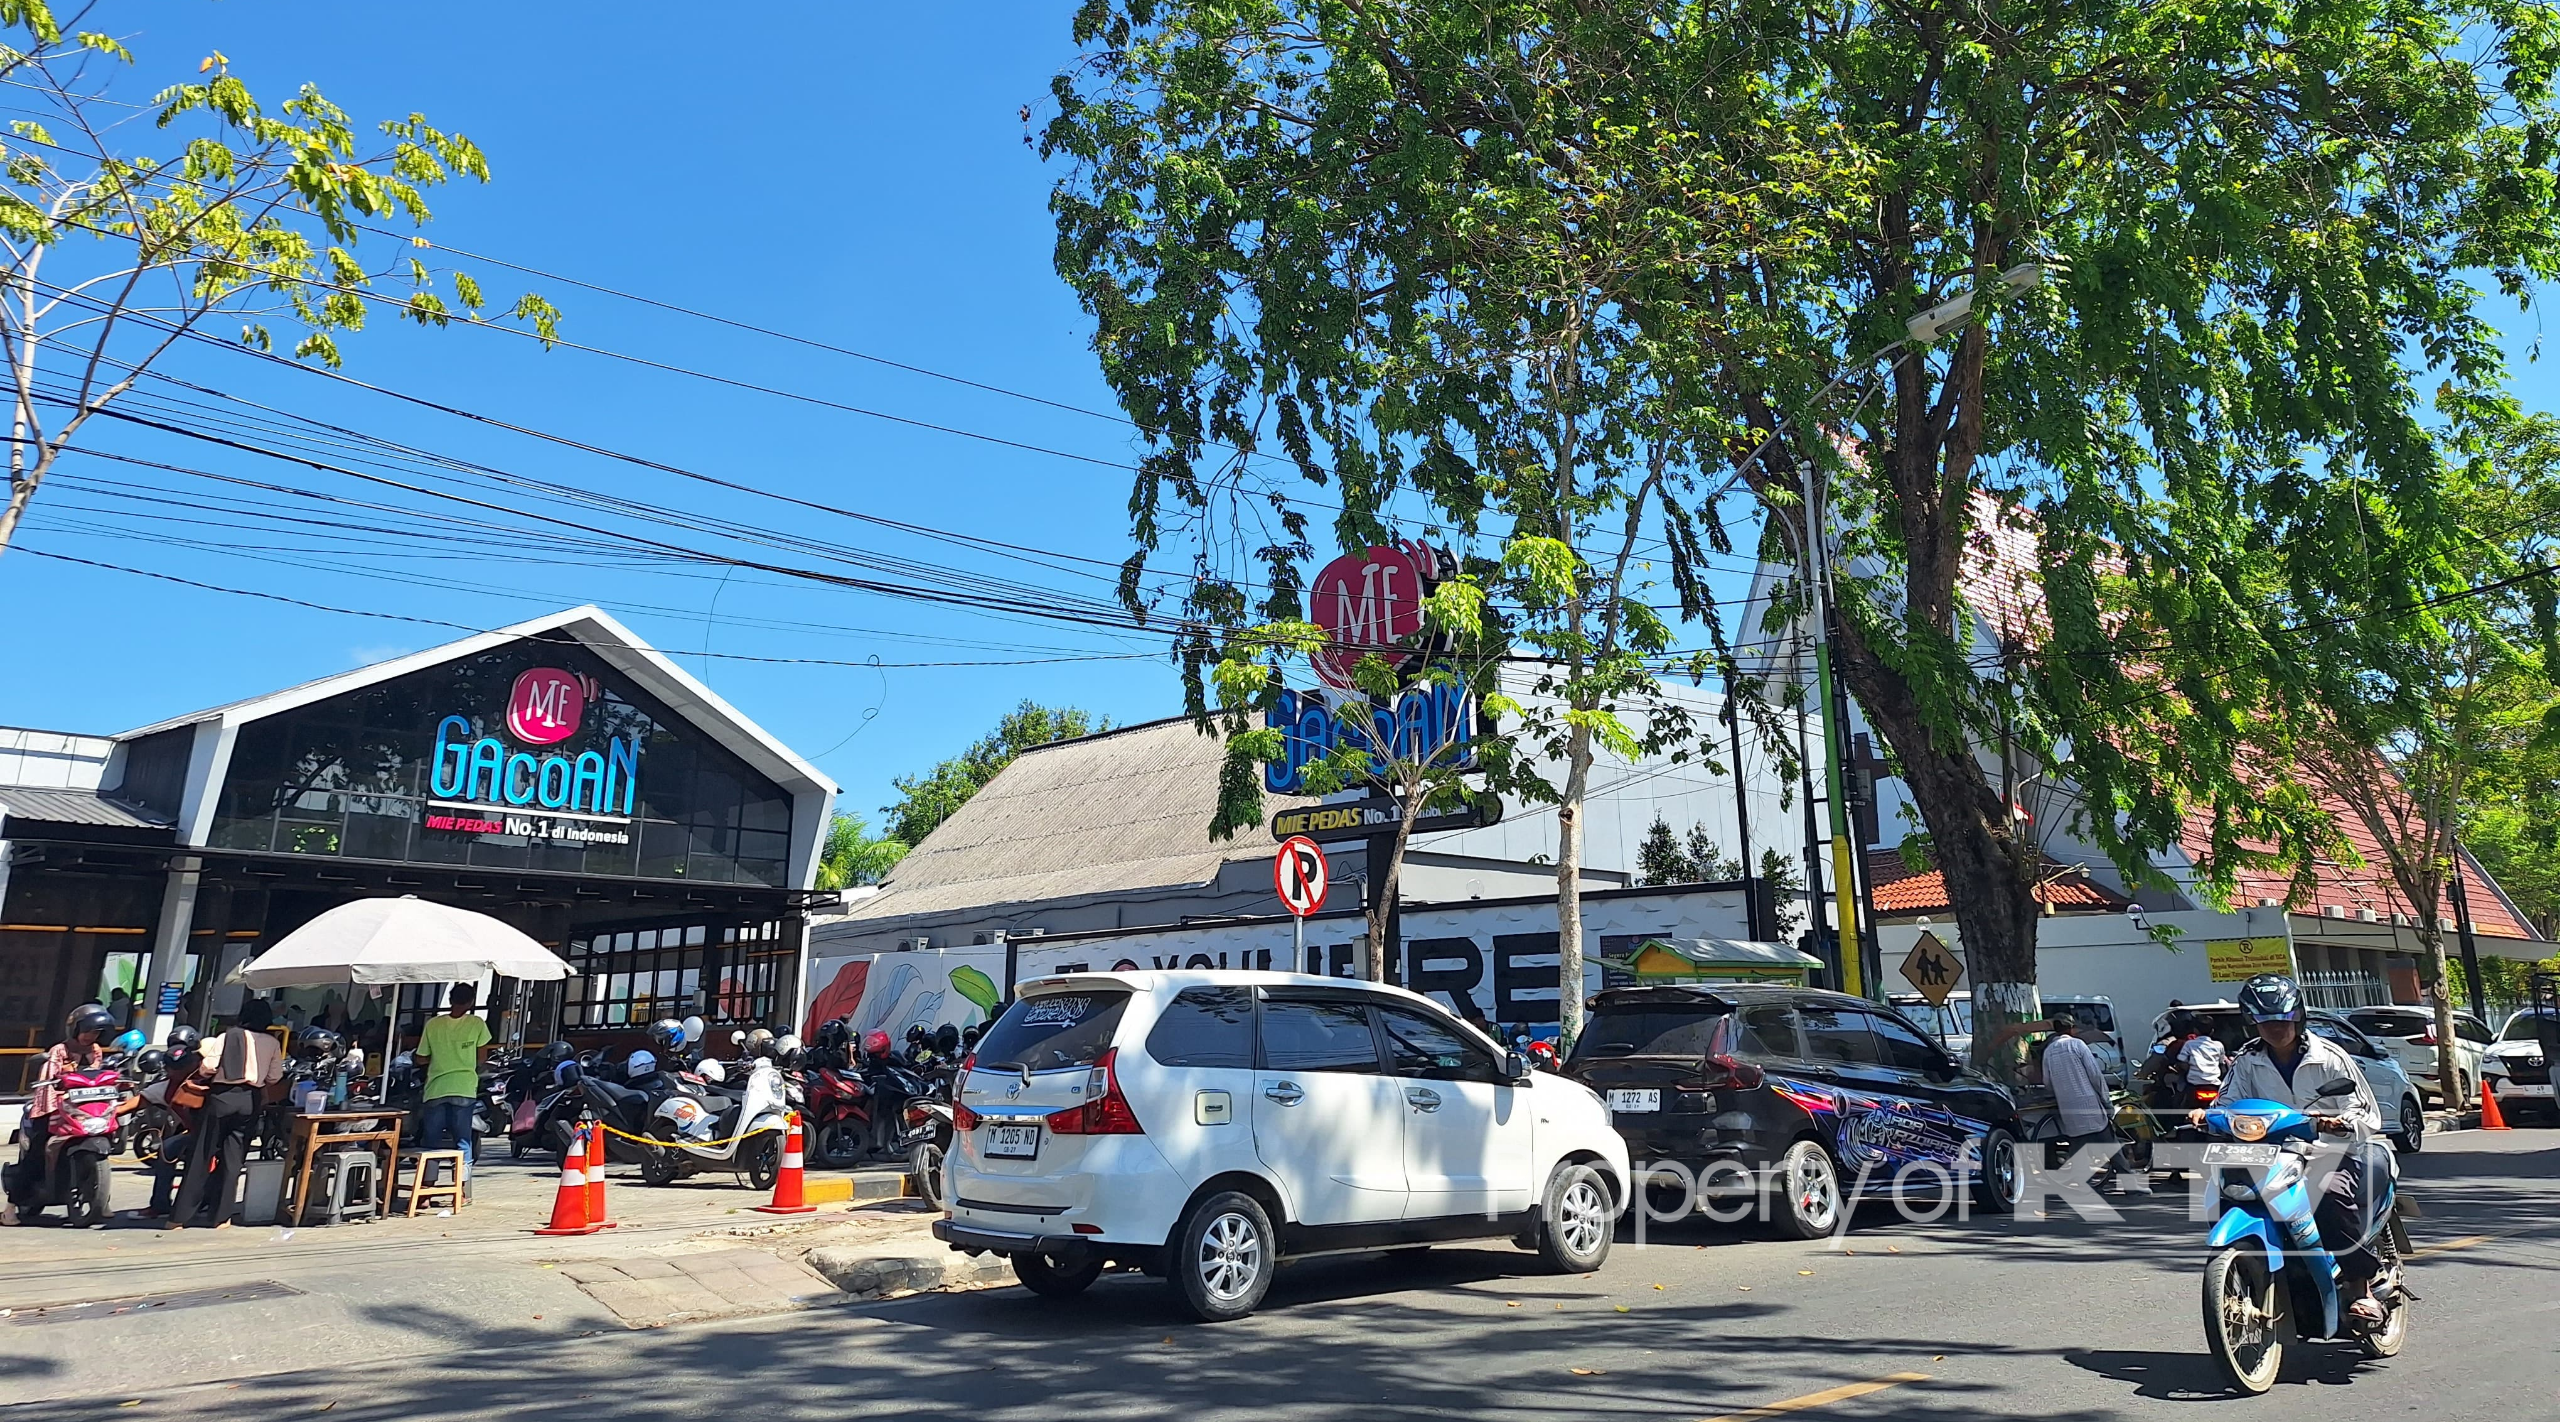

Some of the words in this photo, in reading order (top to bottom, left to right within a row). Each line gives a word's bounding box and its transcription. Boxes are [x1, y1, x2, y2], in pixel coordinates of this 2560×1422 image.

[430, 715, 639, 815] GACOAN
[426, 815, 454, 830] MIE
[455, 818, 503, 834] PEDAS
[552, 827, 566, 840] di
[567, 829, 629, 844] Indonesia
[1276, 815, 1308, 835] MIE
[1309, 807, 1363, 832] PEDAS
[1622, 1091, 1641, 1103] 1272
[1648, 1092, 1658, 1103] AS
[988, 1129, 997, 1144] M
[1000, 1128, 1021, 1145] 1205
[1024, 1130, 1035, 1146] ND
